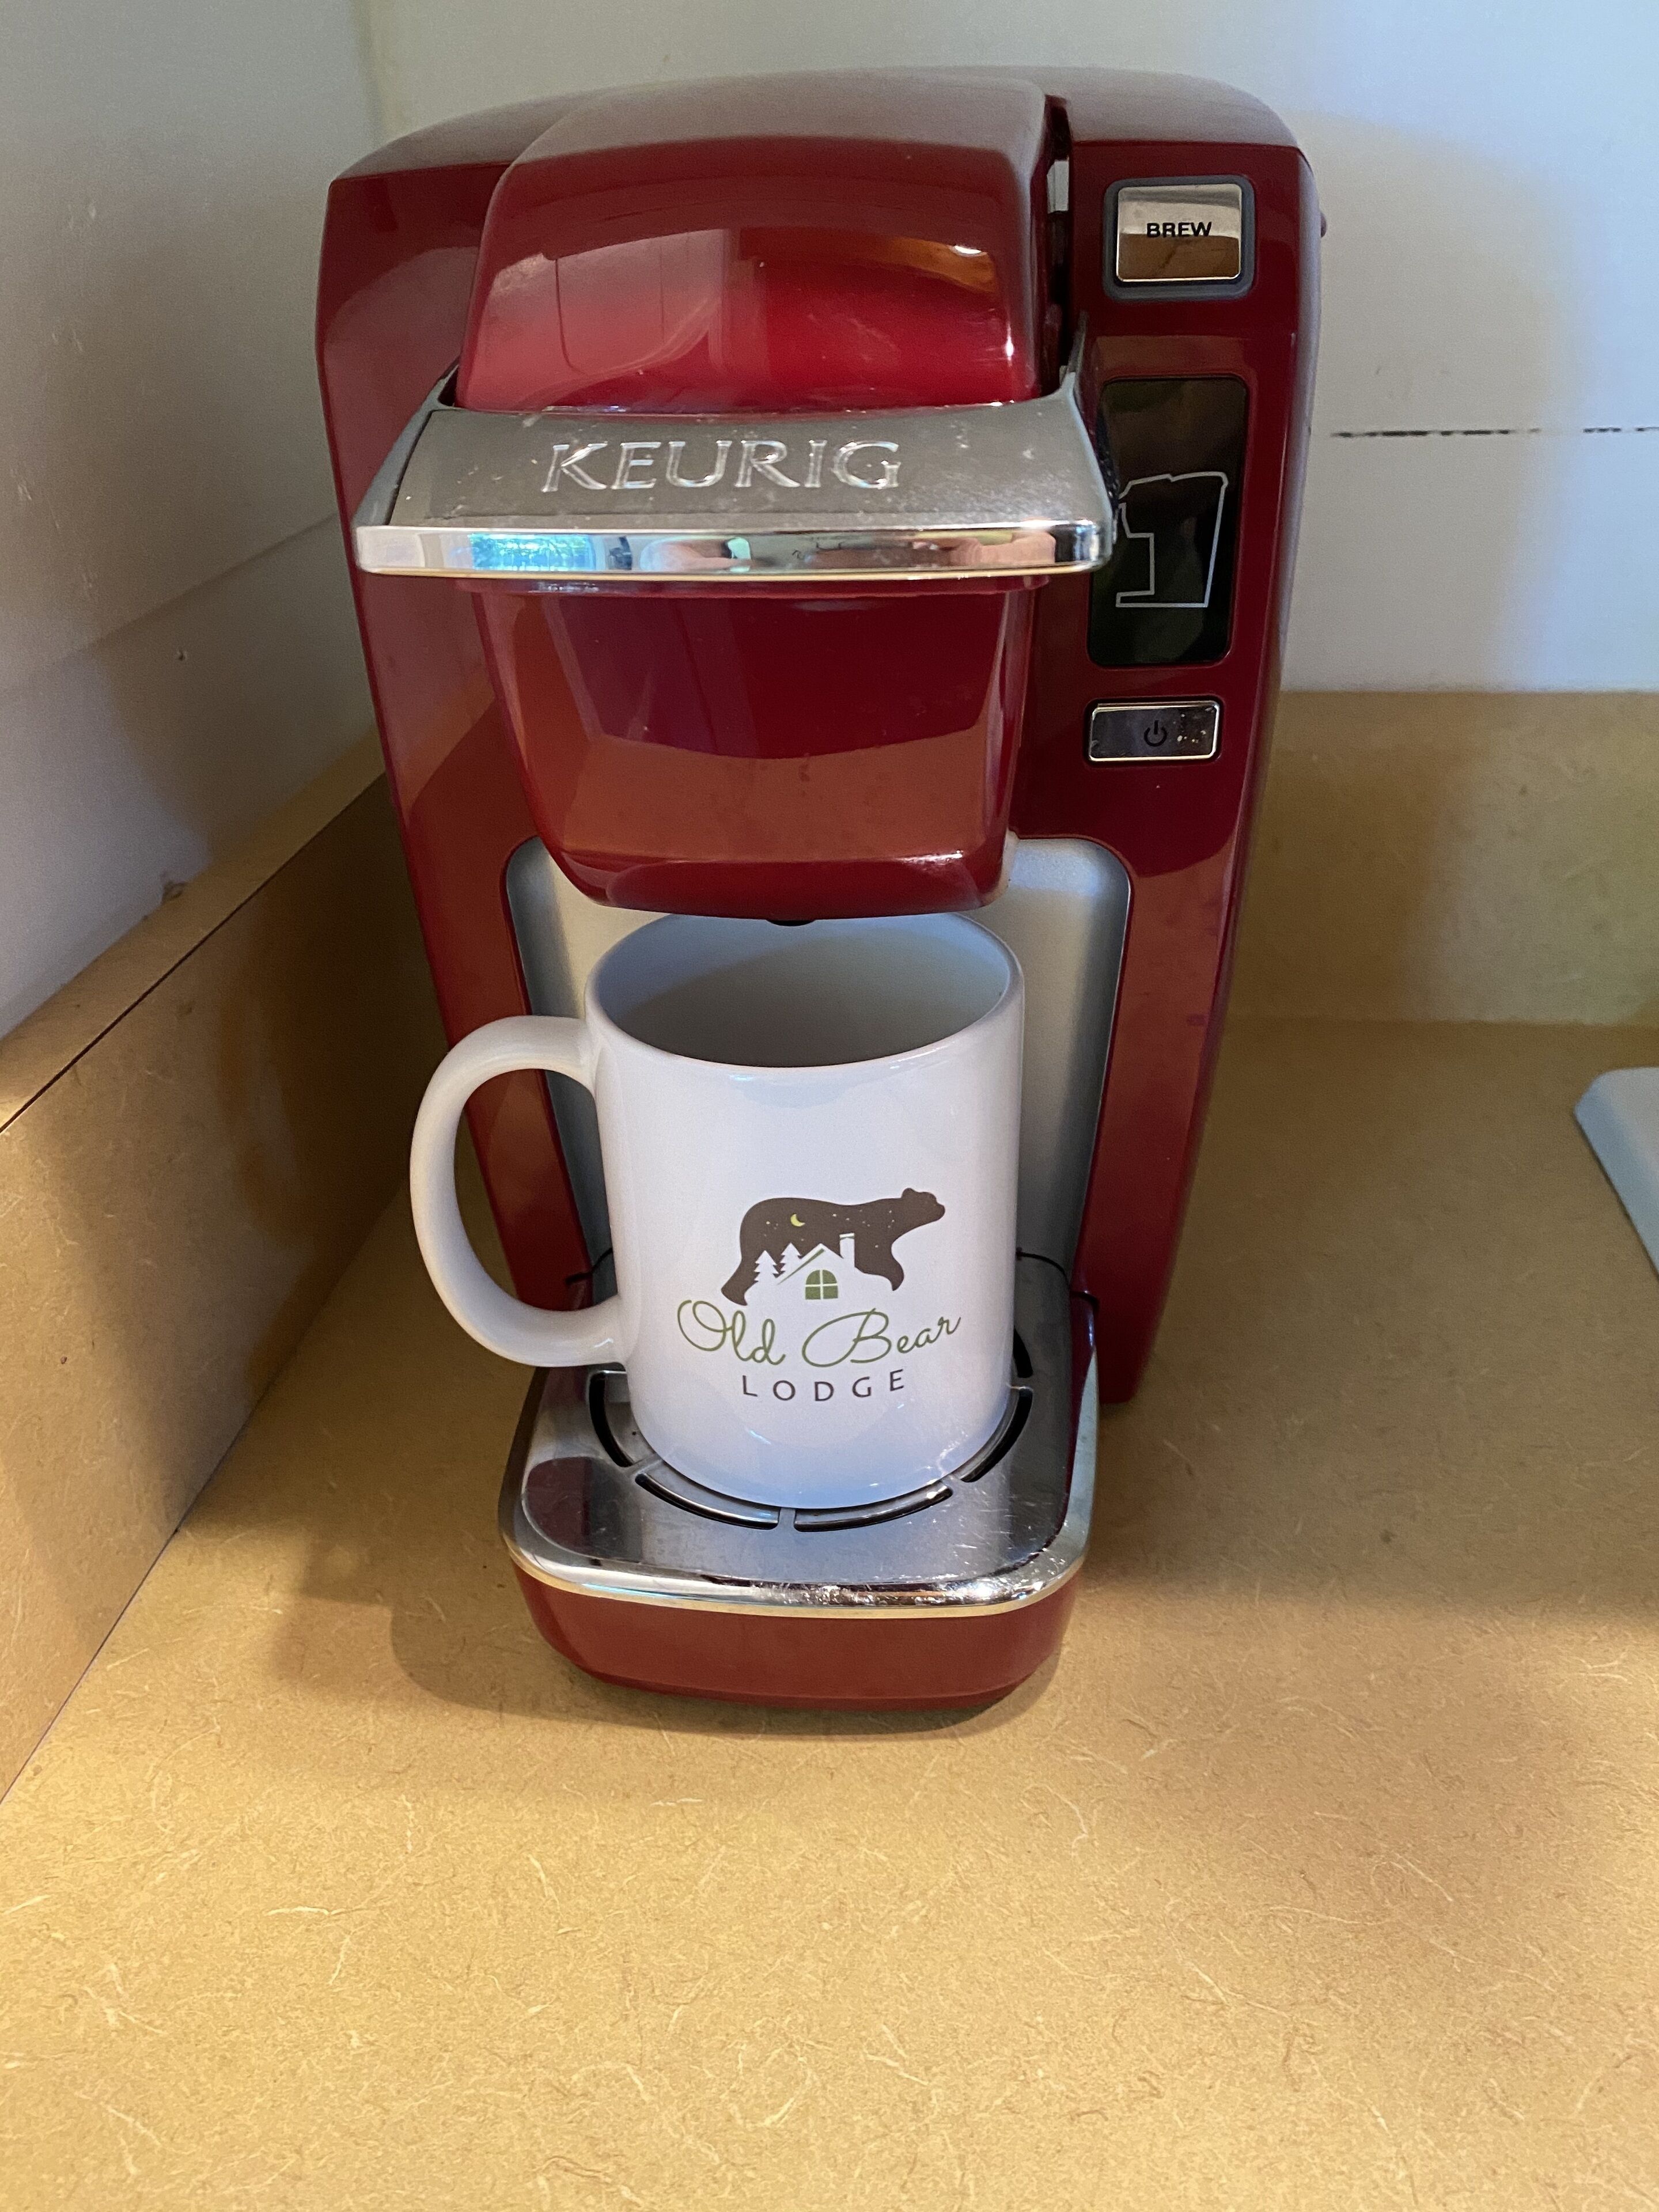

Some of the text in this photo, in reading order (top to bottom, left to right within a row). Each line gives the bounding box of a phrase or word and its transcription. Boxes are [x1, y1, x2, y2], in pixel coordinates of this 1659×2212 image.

[1146, 221, 1212, 238] BREW
[539, 438, 902, 493] KEURIG
[677, 1300, 961, 1368] Old Bear
[742, 1369, 905, 1402] LODGE
